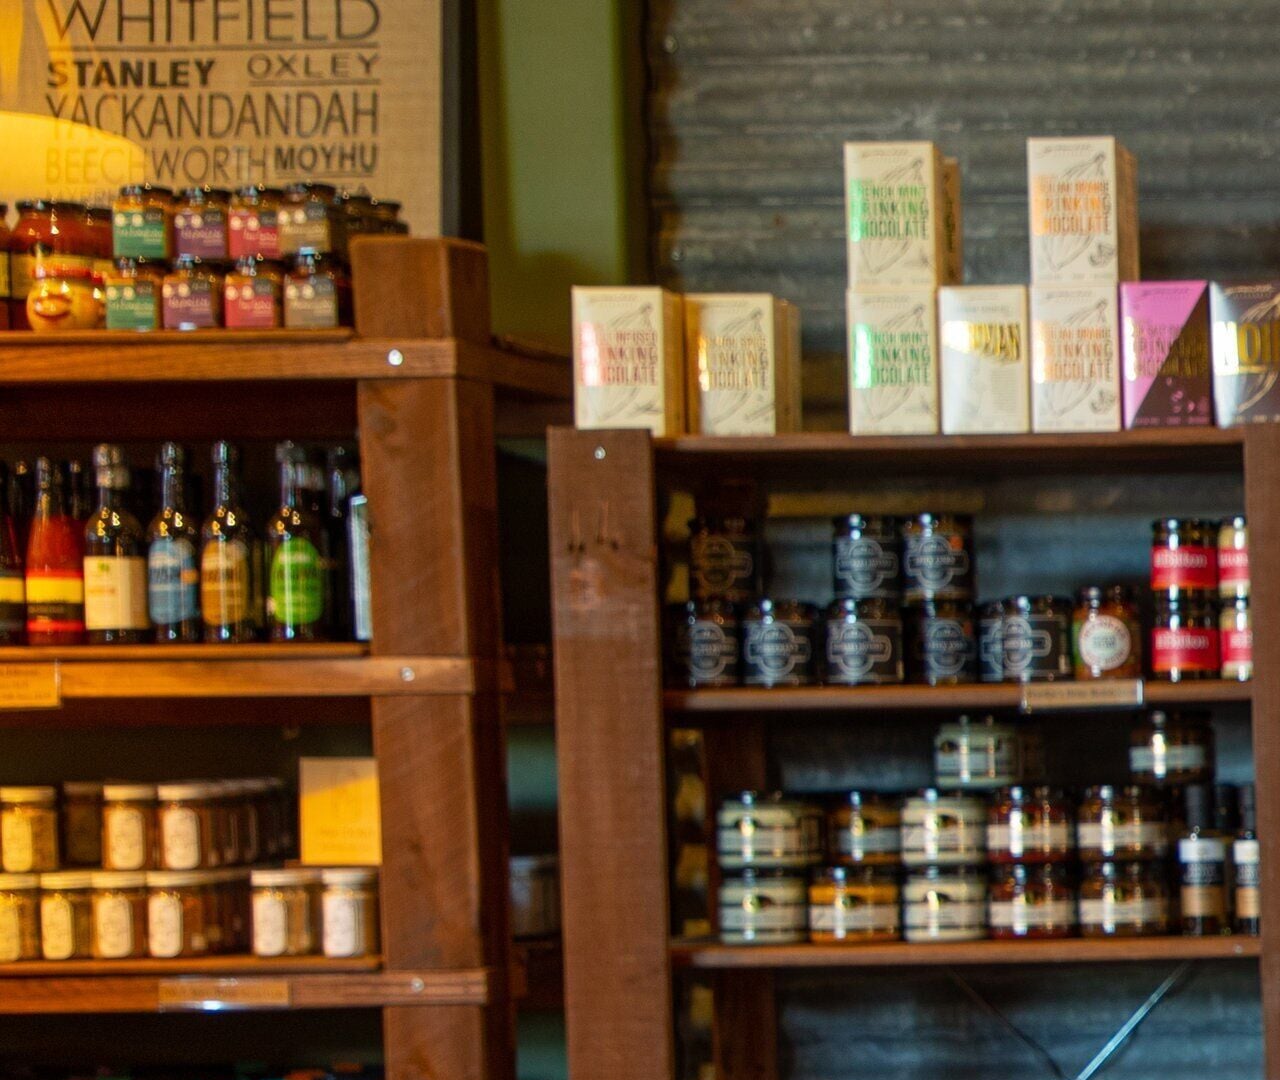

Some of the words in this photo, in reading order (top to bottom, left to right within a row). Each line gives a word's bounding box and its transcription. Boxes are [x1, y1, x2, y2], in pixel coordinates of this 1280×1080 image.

[52, 0, 380, 42] WHITFIELD
[48, 58, 216, 88] STANLEY
[247, 53, 381, 80] OXLEY
[45, 92, 380, 138] YACKANDANDAH
[45, 146, 266, 184] BEECHWORTH
[273, 145, 378, 172] MOYHU
